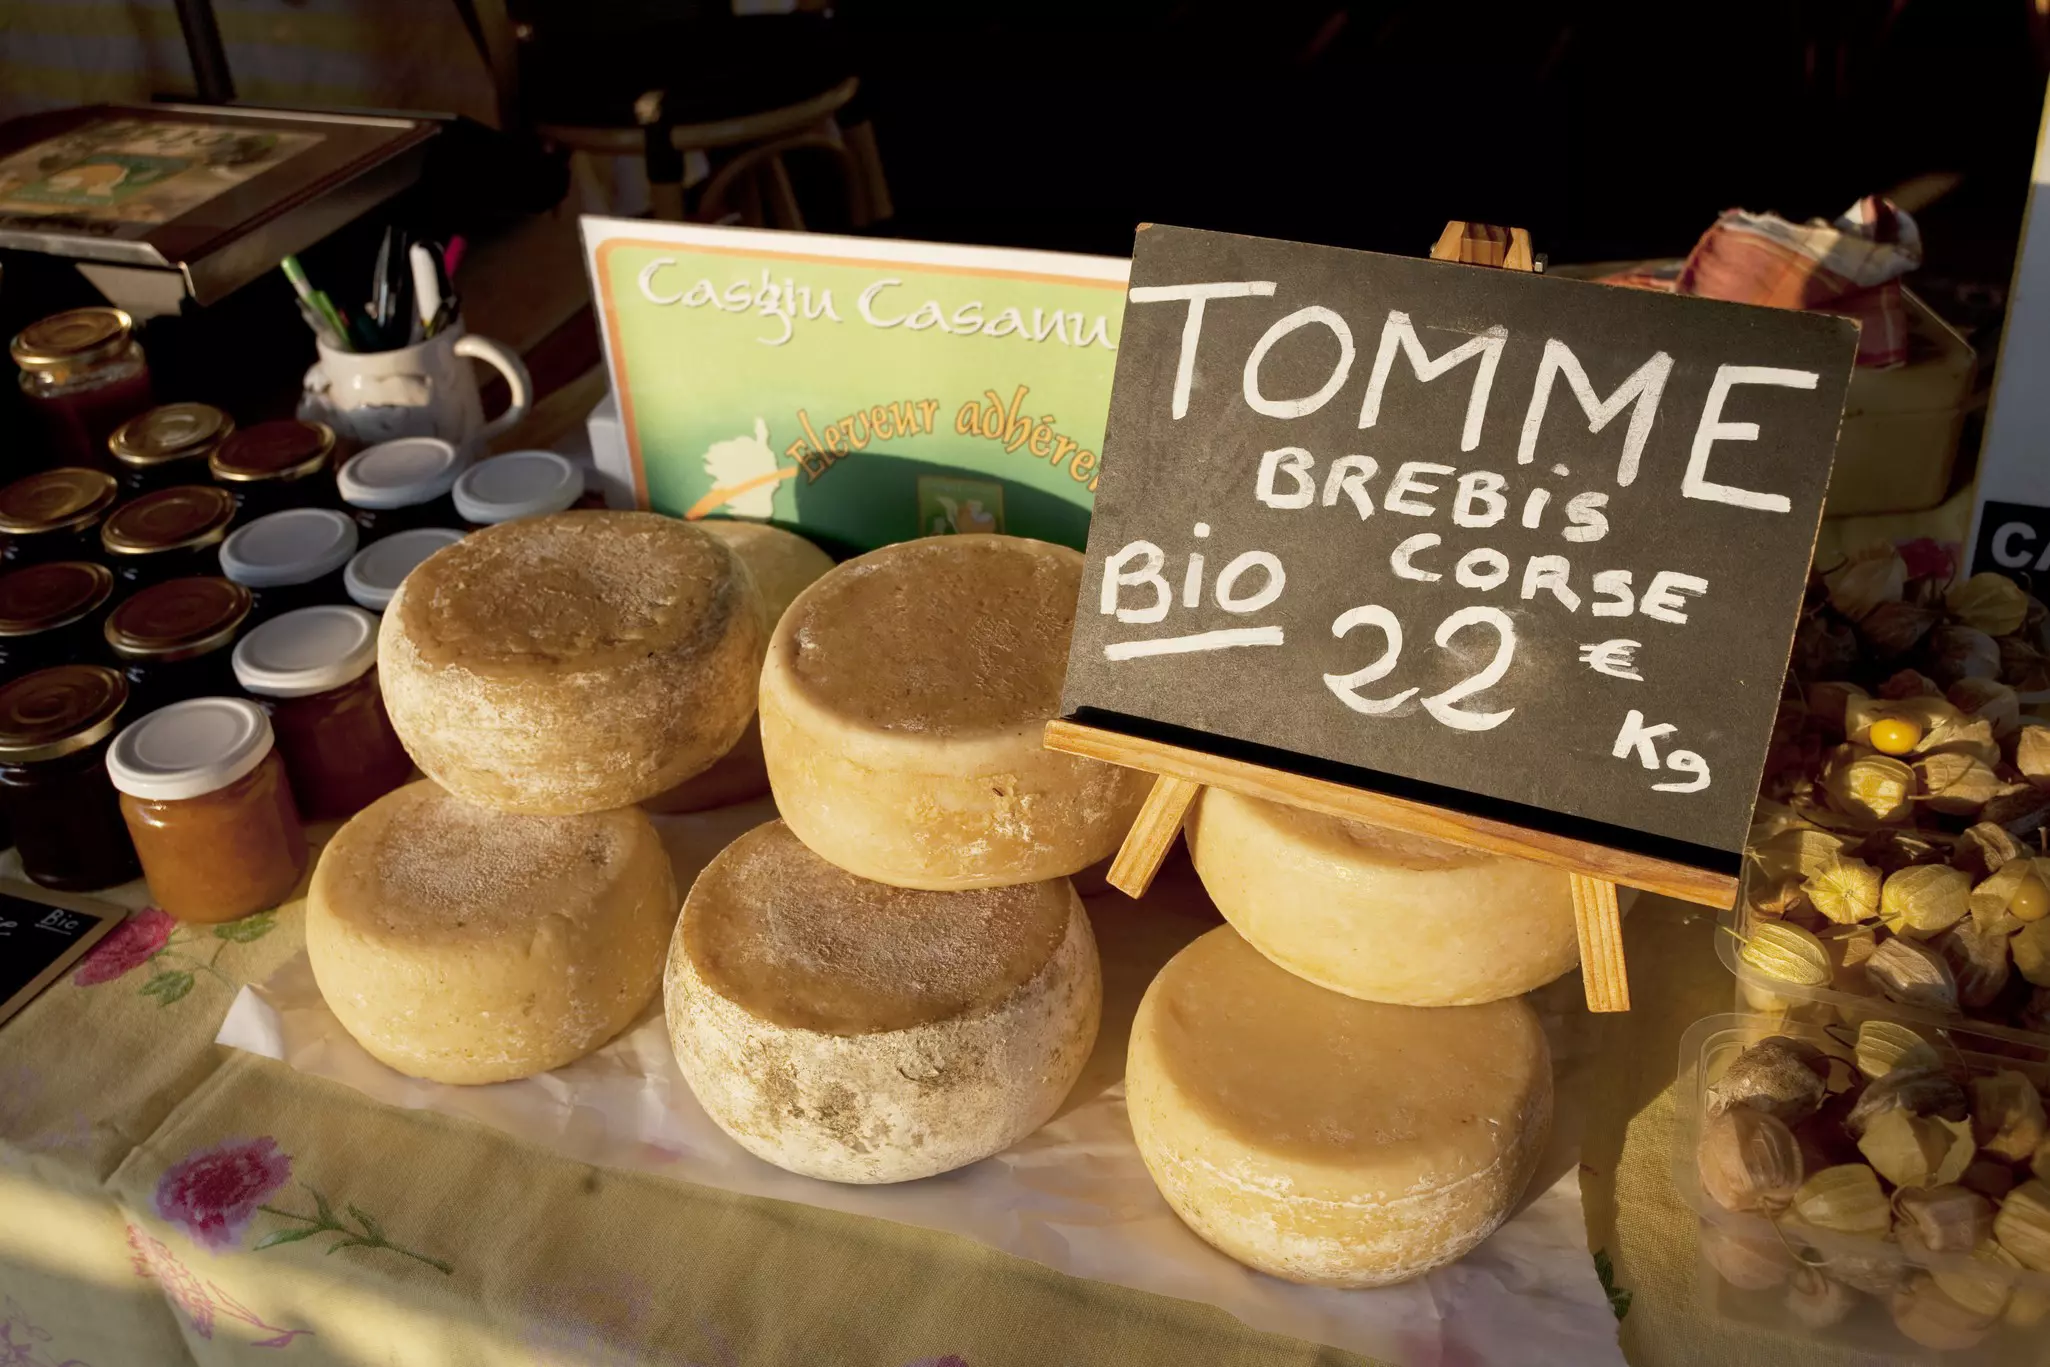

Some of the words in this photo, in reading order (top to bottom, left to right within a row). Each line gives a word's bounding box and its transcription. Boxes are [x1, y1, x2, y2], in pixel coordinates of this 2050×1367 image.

[637, 257, 845, 347] Casgiu
[857, 278, 1118, 351] Casanu
[785, 398, 940, 487] Eleveur
[955, 384, 1100, 493] adhére
[1128, 280, 1820, 513] TOMME
[1100, 522, 1287, 624] Bio
[1390, 533, 1709, 625] CORSE
[1323, 604, 1516, 732] 22
[1578, 638, 1645, 683] €
[1611, 709, 1712, 793] Kg
